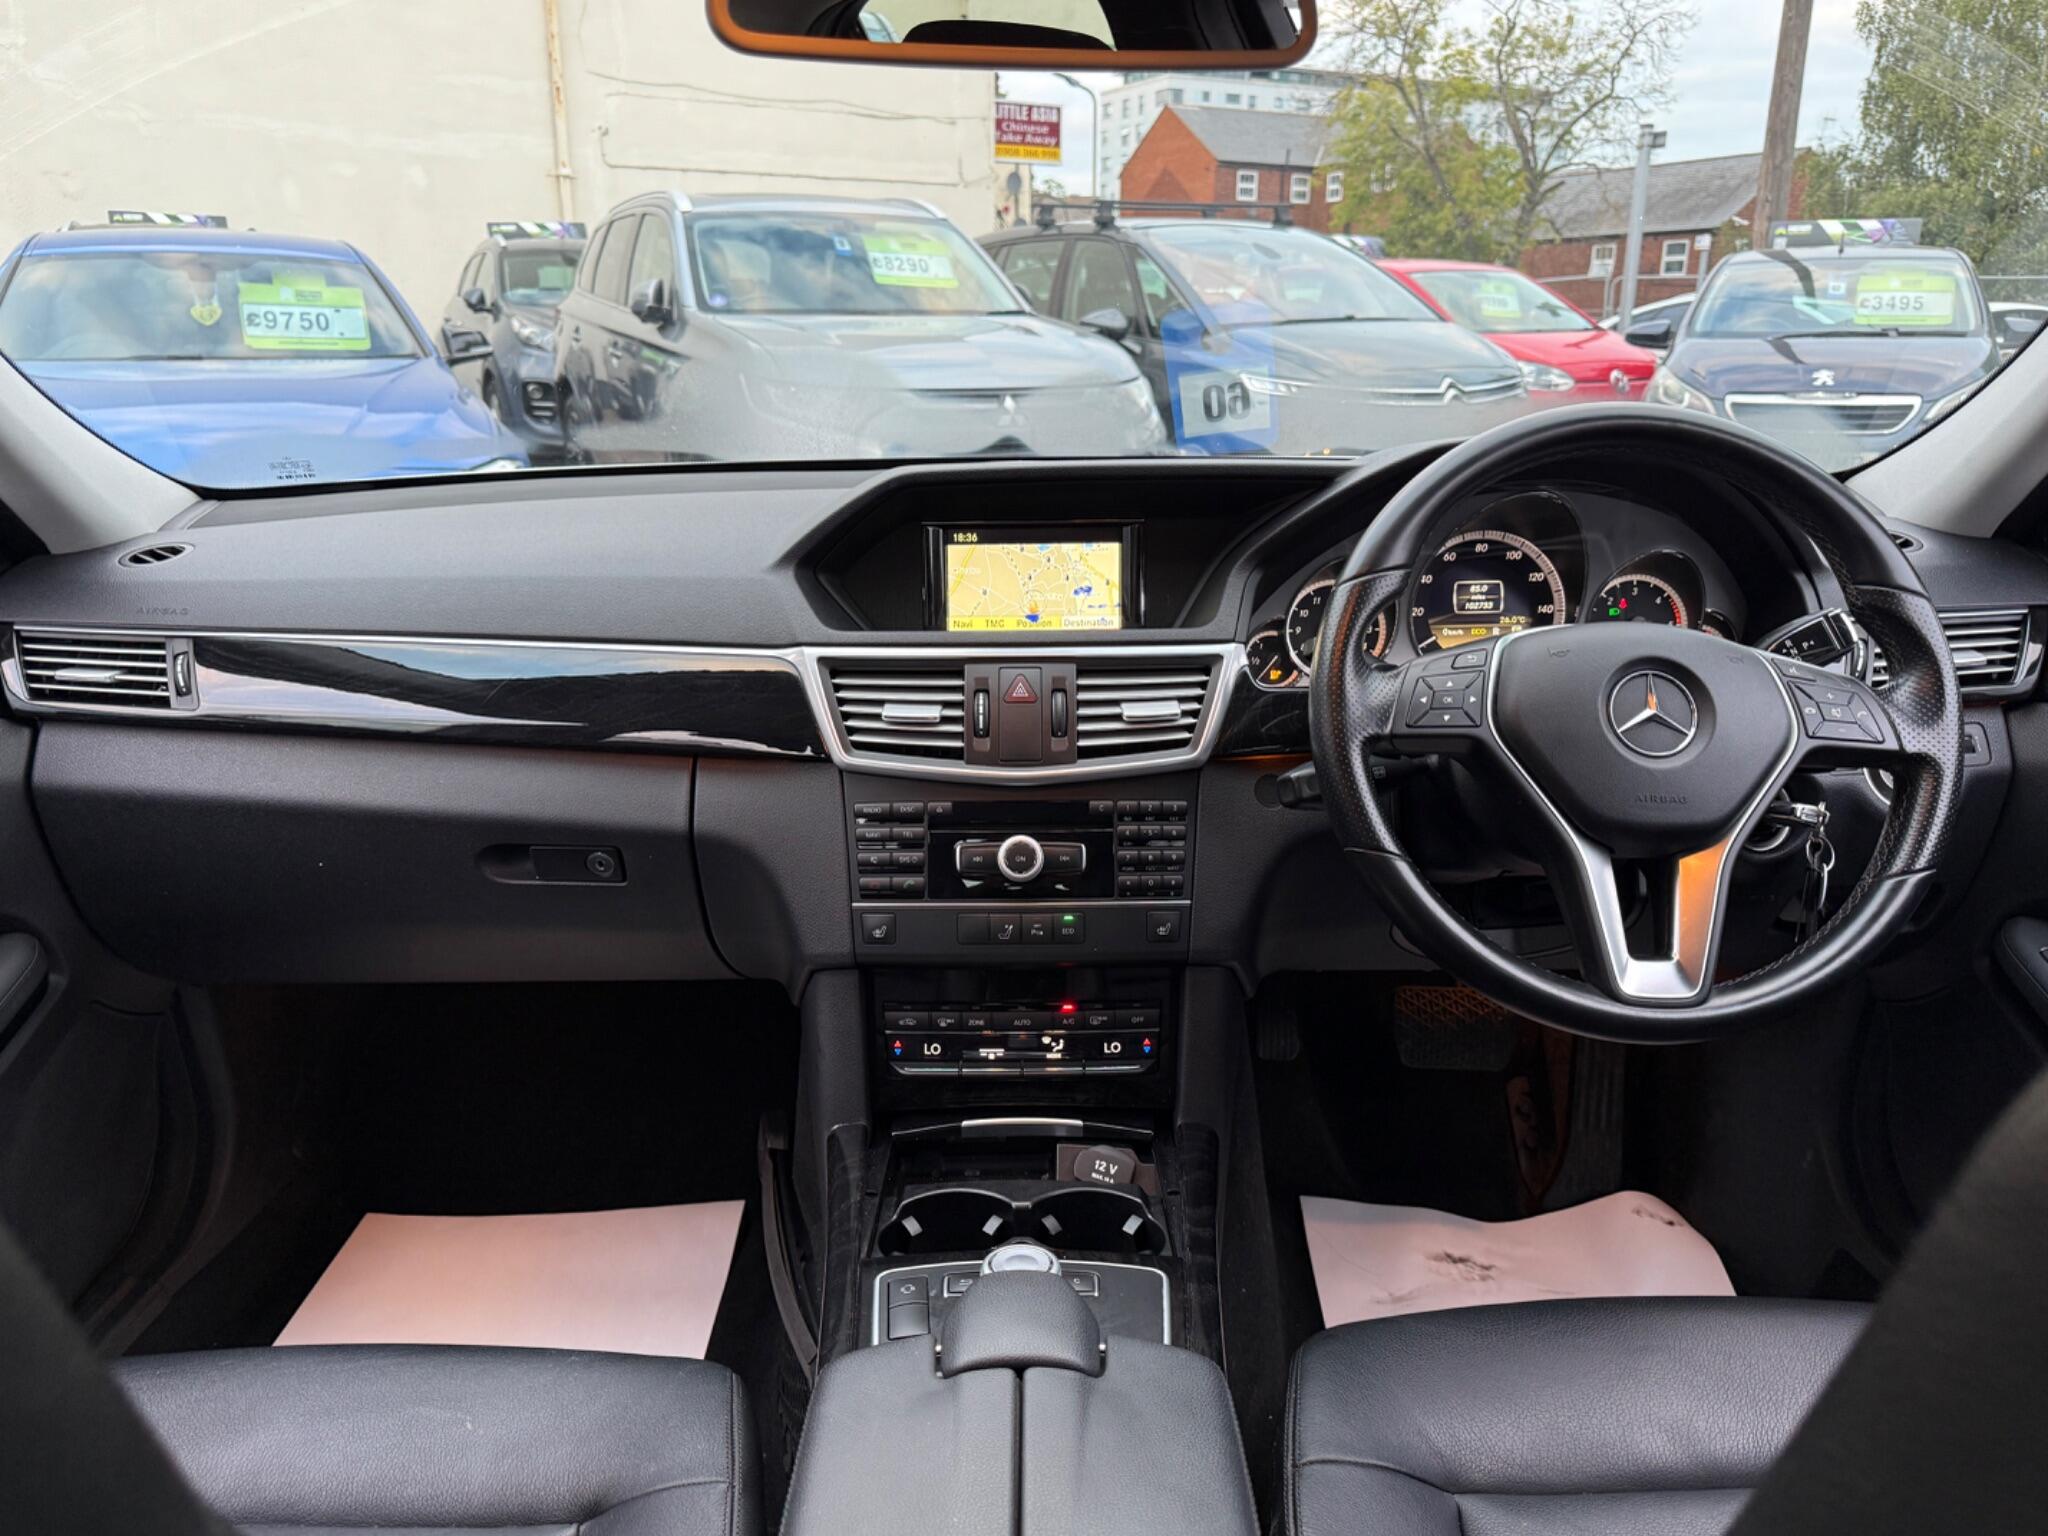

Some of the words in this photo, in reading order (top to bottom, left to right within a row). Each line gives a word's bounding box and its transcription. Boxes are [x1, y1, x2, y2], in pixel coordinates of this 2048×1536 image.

[1001, 121, 1050, 134] Chinese
[1024, 134, 1058, 147] Away
[246, 310, 330, 332] £9750
[953, 532, 978, 542] 18:36
[1475, 543, 1488, 552] 80
[1443, 552, 1456, 561] 60
[1506, 551, 1522, 560] 100
[1529, 572, 1544, 582] 120
[1313, 597, 1320, 605] 11
[1300, 609, 1309, 618] 10
[1412, 607, 1424, 617] 20
[1538, 604, 1554, 614] 140
[953, 619, 973, 628] Navi
[1016, 617, 1052, 628] Poon
[1063, 616, 1114, 627] Destination
[1062, 927, 1074, 935] ECO
[1013, 1018, 1032, 1026] AUTO
[923, 1043, 942, 1056] LO
[1103, 1041, 1122, 1054] LO
[1095, 1160, 1107, 1172] 12
[1109, 1163, 1118, 1175] V
